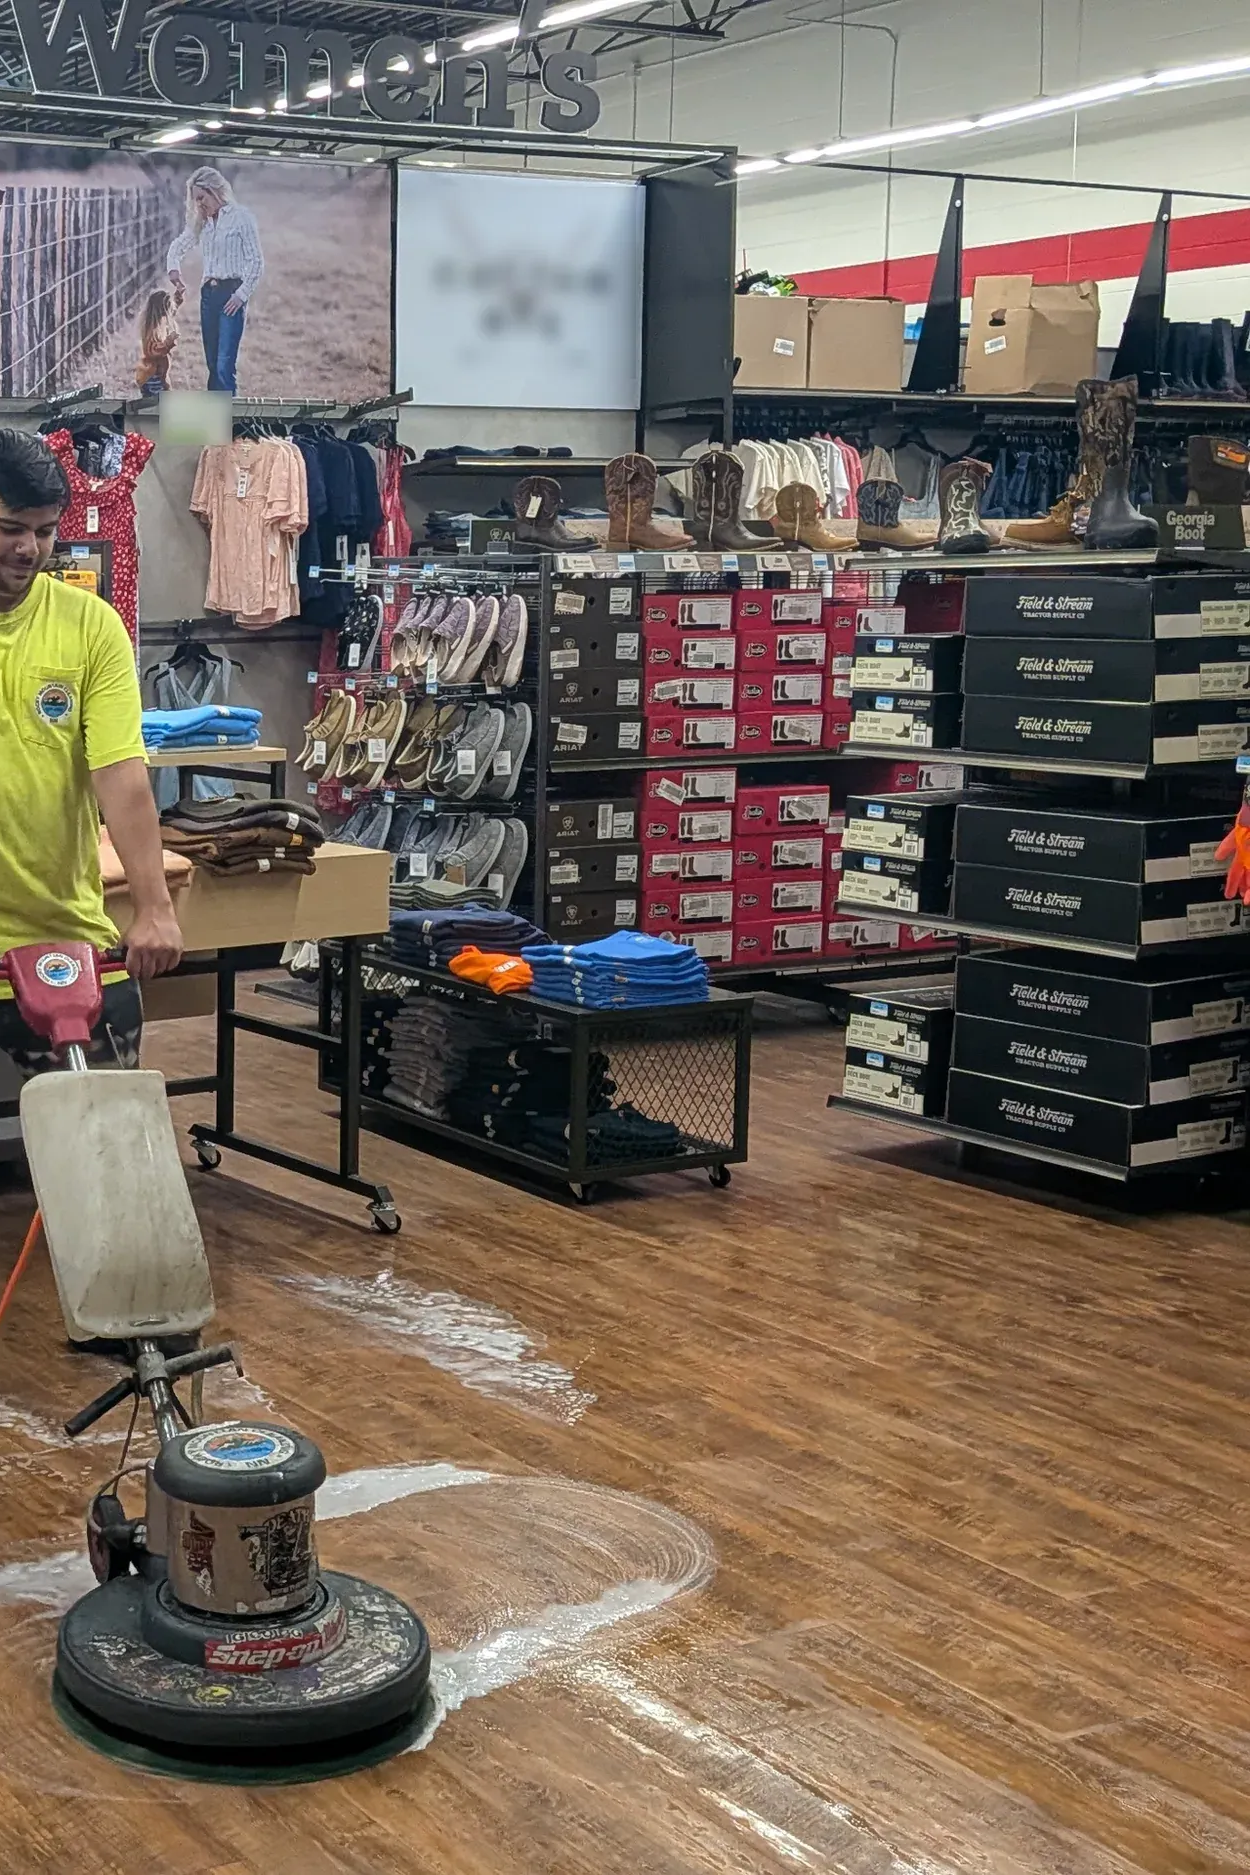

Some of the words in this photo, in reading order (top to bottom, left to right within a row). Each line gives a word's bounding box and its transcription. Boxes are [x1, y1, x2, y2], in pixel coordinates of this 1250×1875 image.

[1166, 510, 1215, 529] Georgia
[1175, 525, 1205, 540] Boot
[1016, 596, 1045, 609] Field
[1043, 597, 1054, 609] &
[1055, 596, 1093, 610] Stream
[1016, 658, 1045, 671] Field
[1044, 658, 1055, 671] &
[1055, 658, 1094, 674] Stream
[1015, 716, 1043, 731] Field
[1043, 719, 1053, 732] &
[1054, 719, 1092, 734] Stream
[553, 743, 584, 752] ARIAT
[1008, 829, 1036, 844] Field
[1036, 832, 1046, 845] &
[1046, 833, 1085, 850] Stream
[1005, 888, 1034, 903] Field
[1033, 891, 1043, 904] &
[1044, 893, 1081, 909] Stream
[1010, 983, 1039, 1000] Field
[1038, 989, 1049, 1002] &
[1050, 990, 1089, 1009] Stream
[1008, 1042, 1037, 1058] Field
[1037, 1047, 1047, 1060] &
[1048, 1049, 1088, 1068] Stream
[998, 1098, 1027, 1115] Field
[1026, 1105, 1036, 1117] &
[1037, 1107, 1074, 1126] Stream
